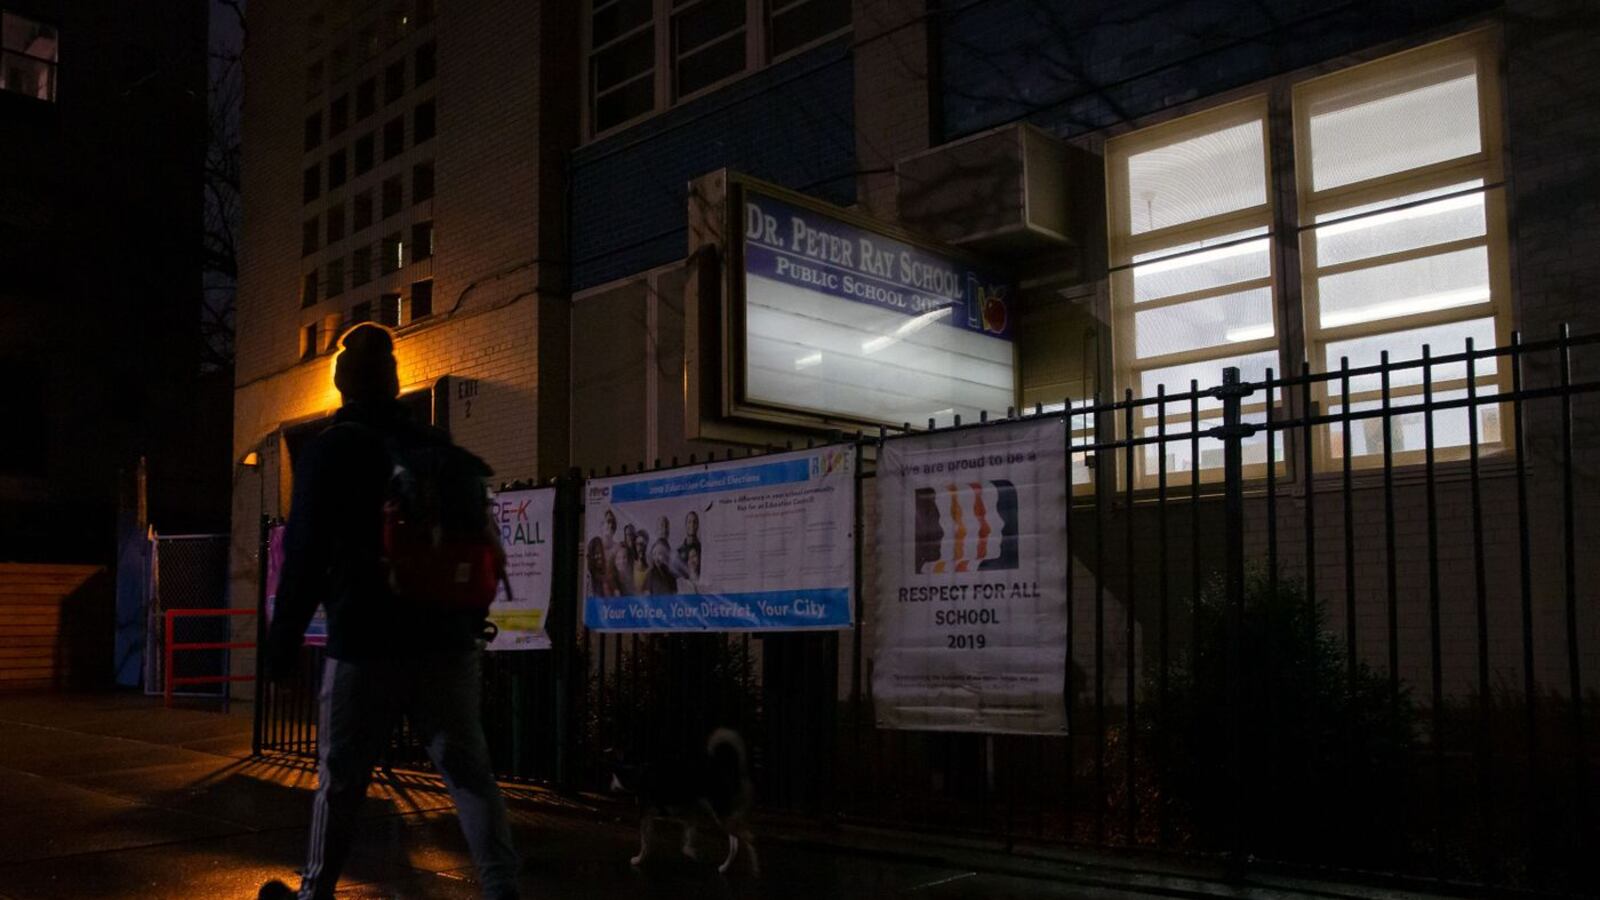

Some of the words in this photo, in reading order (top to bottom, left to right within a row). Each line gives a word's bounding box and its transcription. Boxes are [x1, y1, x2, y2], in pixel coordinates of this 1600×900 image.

[746, 202, 784, 247] DR.
[791, 216, 853, 267] PETER
[859, 239, 896, 280] RAY
[900, 251, 963, 299] SCHOOL
[776, 257, 839, 290] PUBLIC
[843, 276, 907, 308] SCHOOL
[458, 377, 479, 399] EXIT
[464, 399, 472, 419] 2
[923, 463, 944, 474] are
[947, 457, 985, 474] proud
[989, 455, 1003, 466] to
[1006, 453, 1024, 464] be
[1027, 452, 1037, 461] a
[700, 476, 726, 489] Council
[728, 474, 761, 484] Elections
[494, 499, 532, 523] RE-K
[898, 585, 969, 602] RESPECT
[974, 584, 1006, 600] FOR
[1010, 582, 1042, 599] ALL
[602, 605, 626, 620] Your
[628, 604, 668, 620] Voice,
[670, 602, 698, 619] Your
[700, 601, 756, 619] District,
[757, 599, 790, 617] Your
[792, 598, 827, 619] City
[936, 608, 999, 626] SCHOOL
[947, 633, 986, 649] 2019
